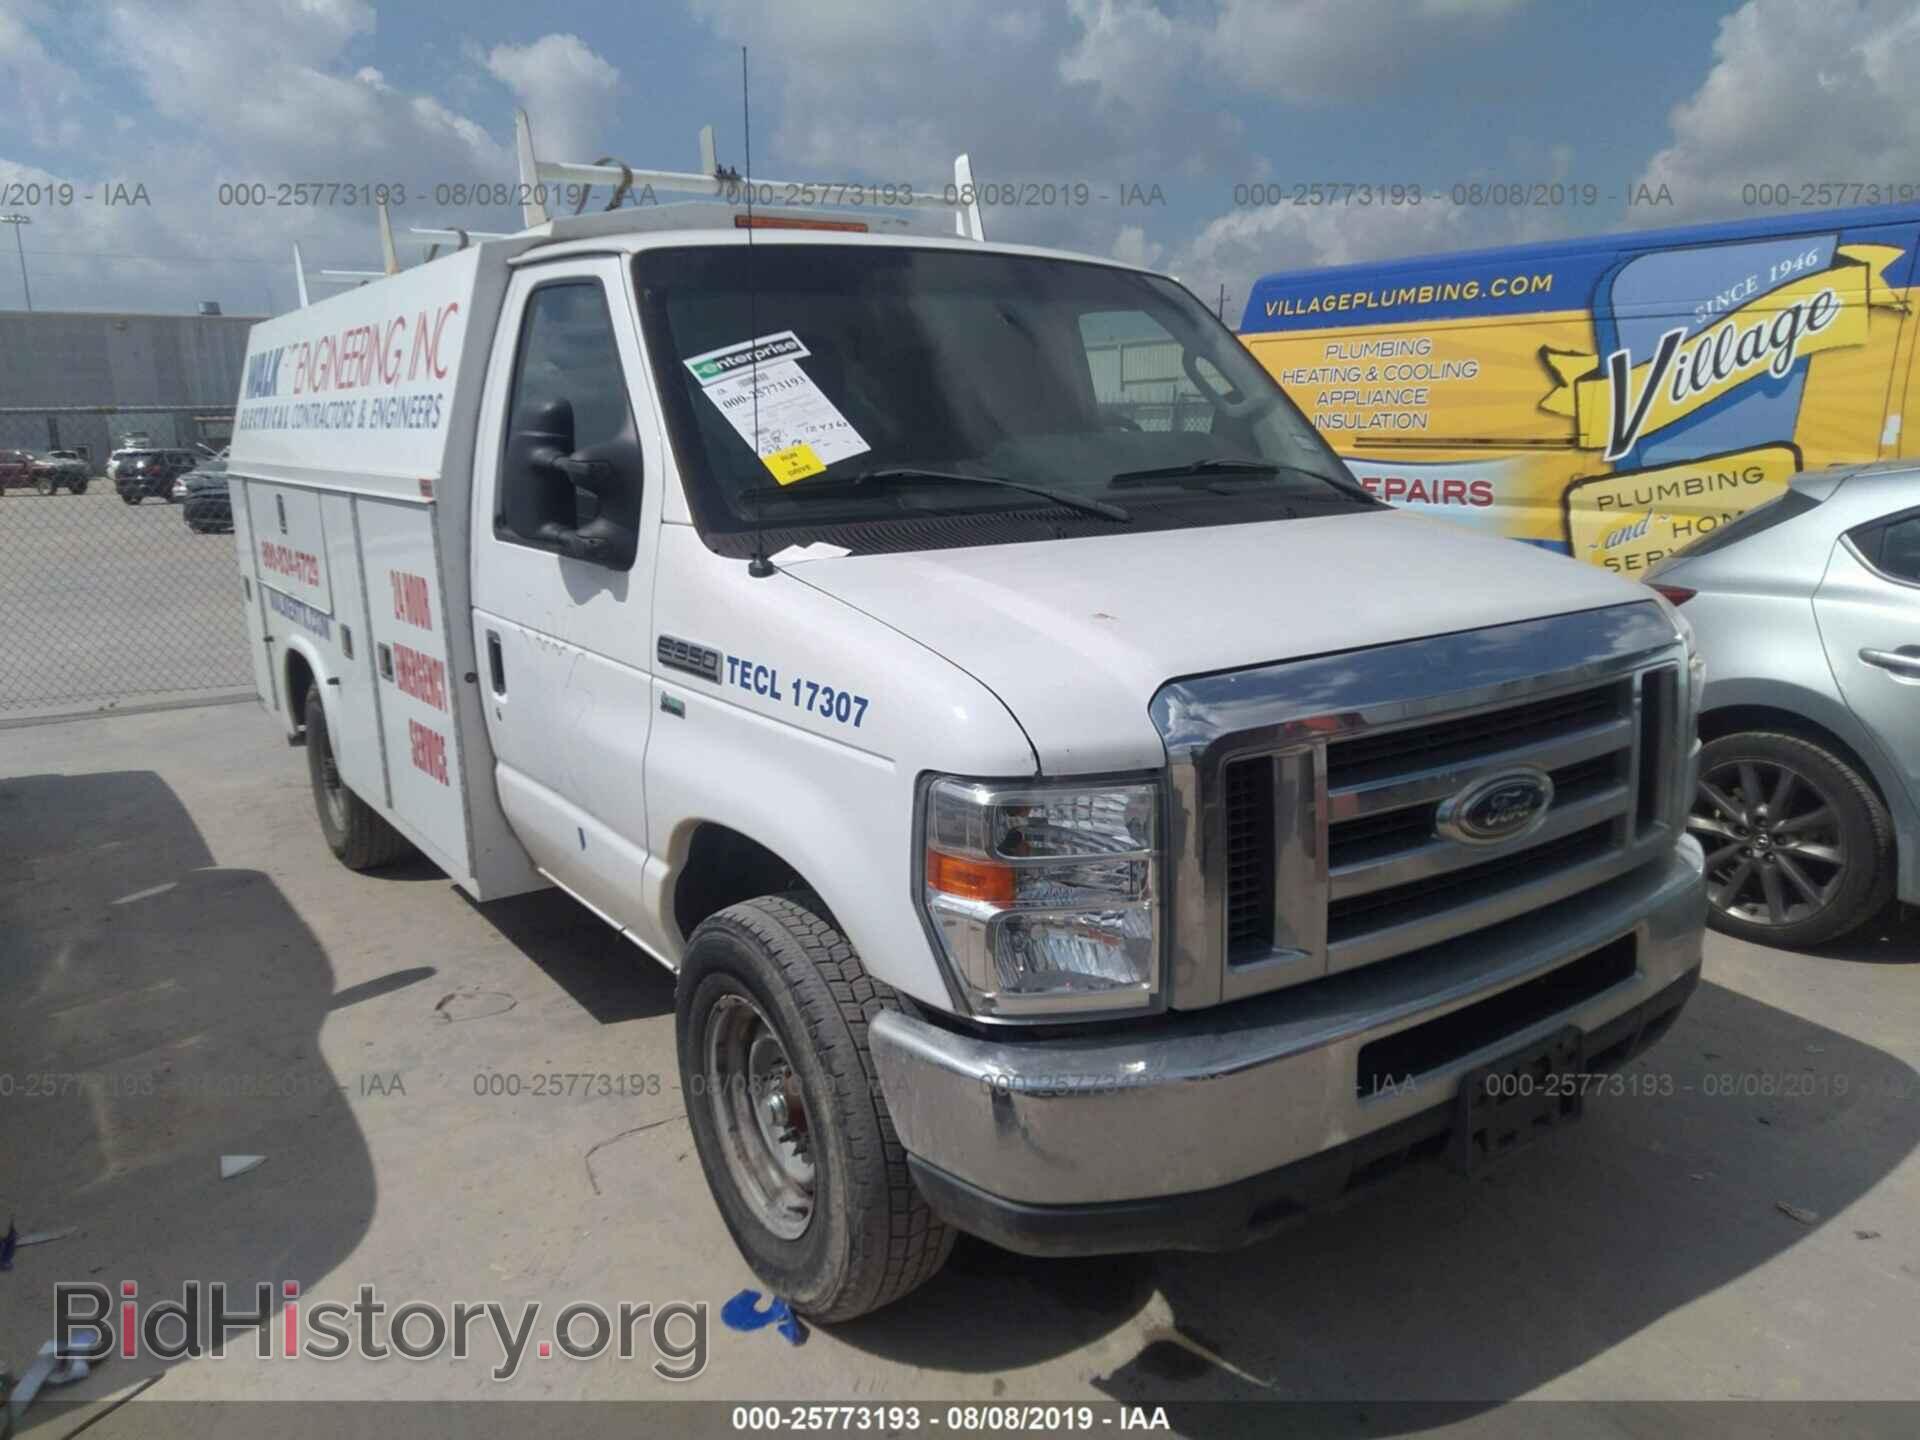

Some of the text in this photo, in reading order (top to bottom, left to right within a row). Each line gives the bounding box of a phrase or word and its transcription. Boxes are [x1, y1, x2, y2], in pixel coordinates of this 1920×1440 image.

[1265, 274, 1553, 317] VILLAGEPLUMBING.COM
[1694, 247, 1819, 324] SINCE 1946
[408, 302, 458, 381] INC
[702, 341, 798, 372] enterprise
[1324, 338, 1432, 360] PLUMBING
[1282, 360, 1479, 385] HEATING & COOLING
[1604, 288, 1843, 462] Village
[291, 399, 357, 430] CONTRACTORS
[369, 392, 444, 430] ENGINEERS
[1316, 387, 1430, 406] APPLIANCE
[1313, 411, 1429, 431] INSULATION
[1597, 466, 1765, 512] PLUMBING
[1604, 507, 1654, 550] and
[727, 655, 869, 729] TECL 17307
